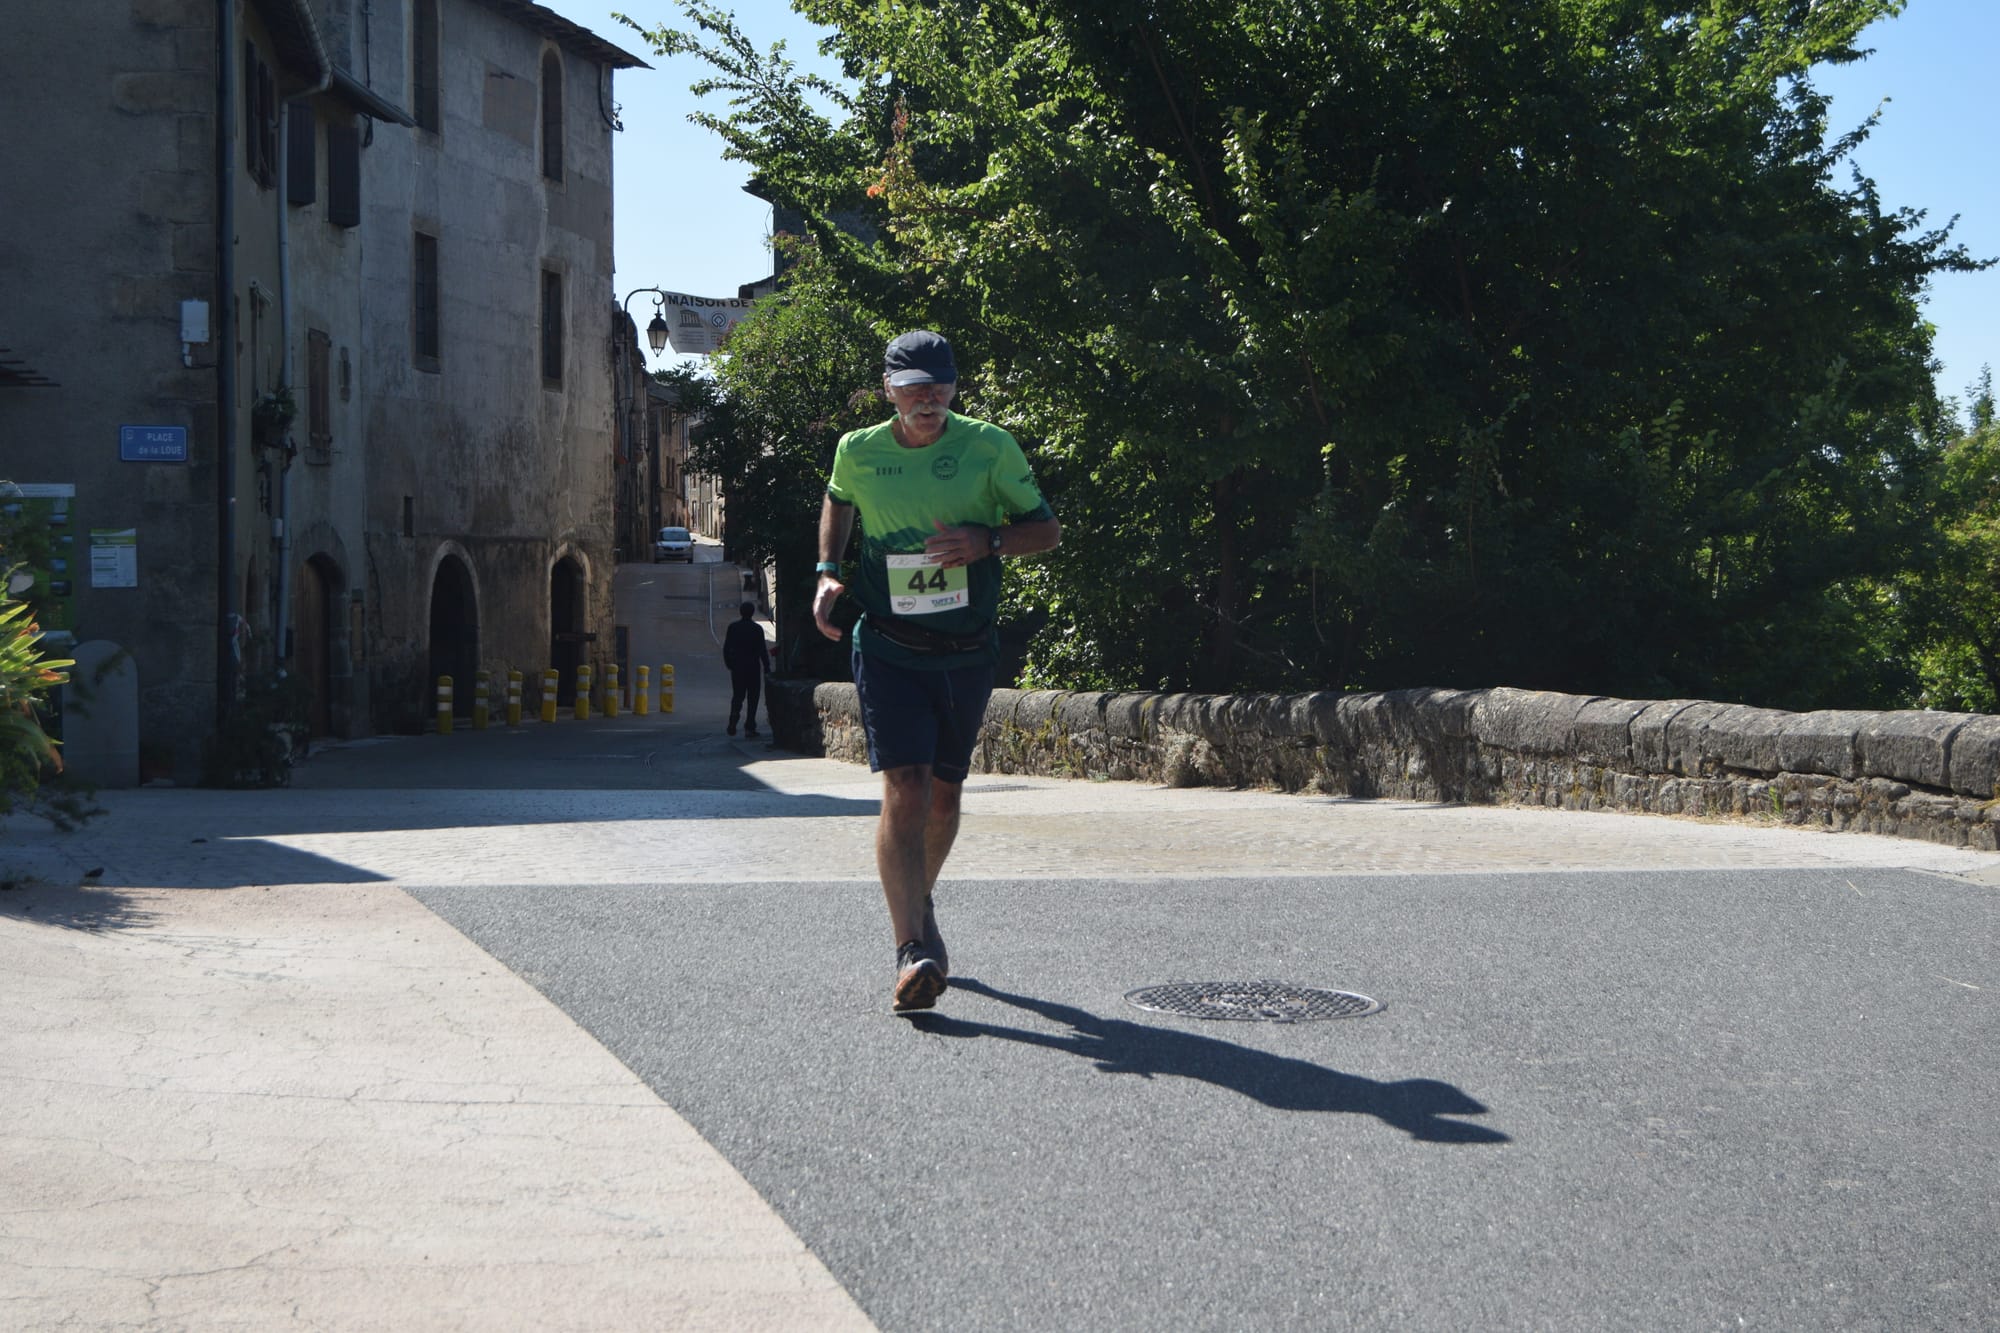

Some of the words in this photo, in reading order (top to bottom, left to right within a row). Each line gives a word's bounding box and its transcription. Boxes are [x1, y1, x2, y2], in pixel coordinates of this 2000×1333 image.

[668, 295, 726, 307] MAISON
[730, 299, 749, 308] DE
[146, 432, 176, 442] PLACE
[138, 445, 149, 455] de
[151, 445, 159, 455] la
[160, 445, 183, 455] LOUE
[908, 568, 948, 593] 44
